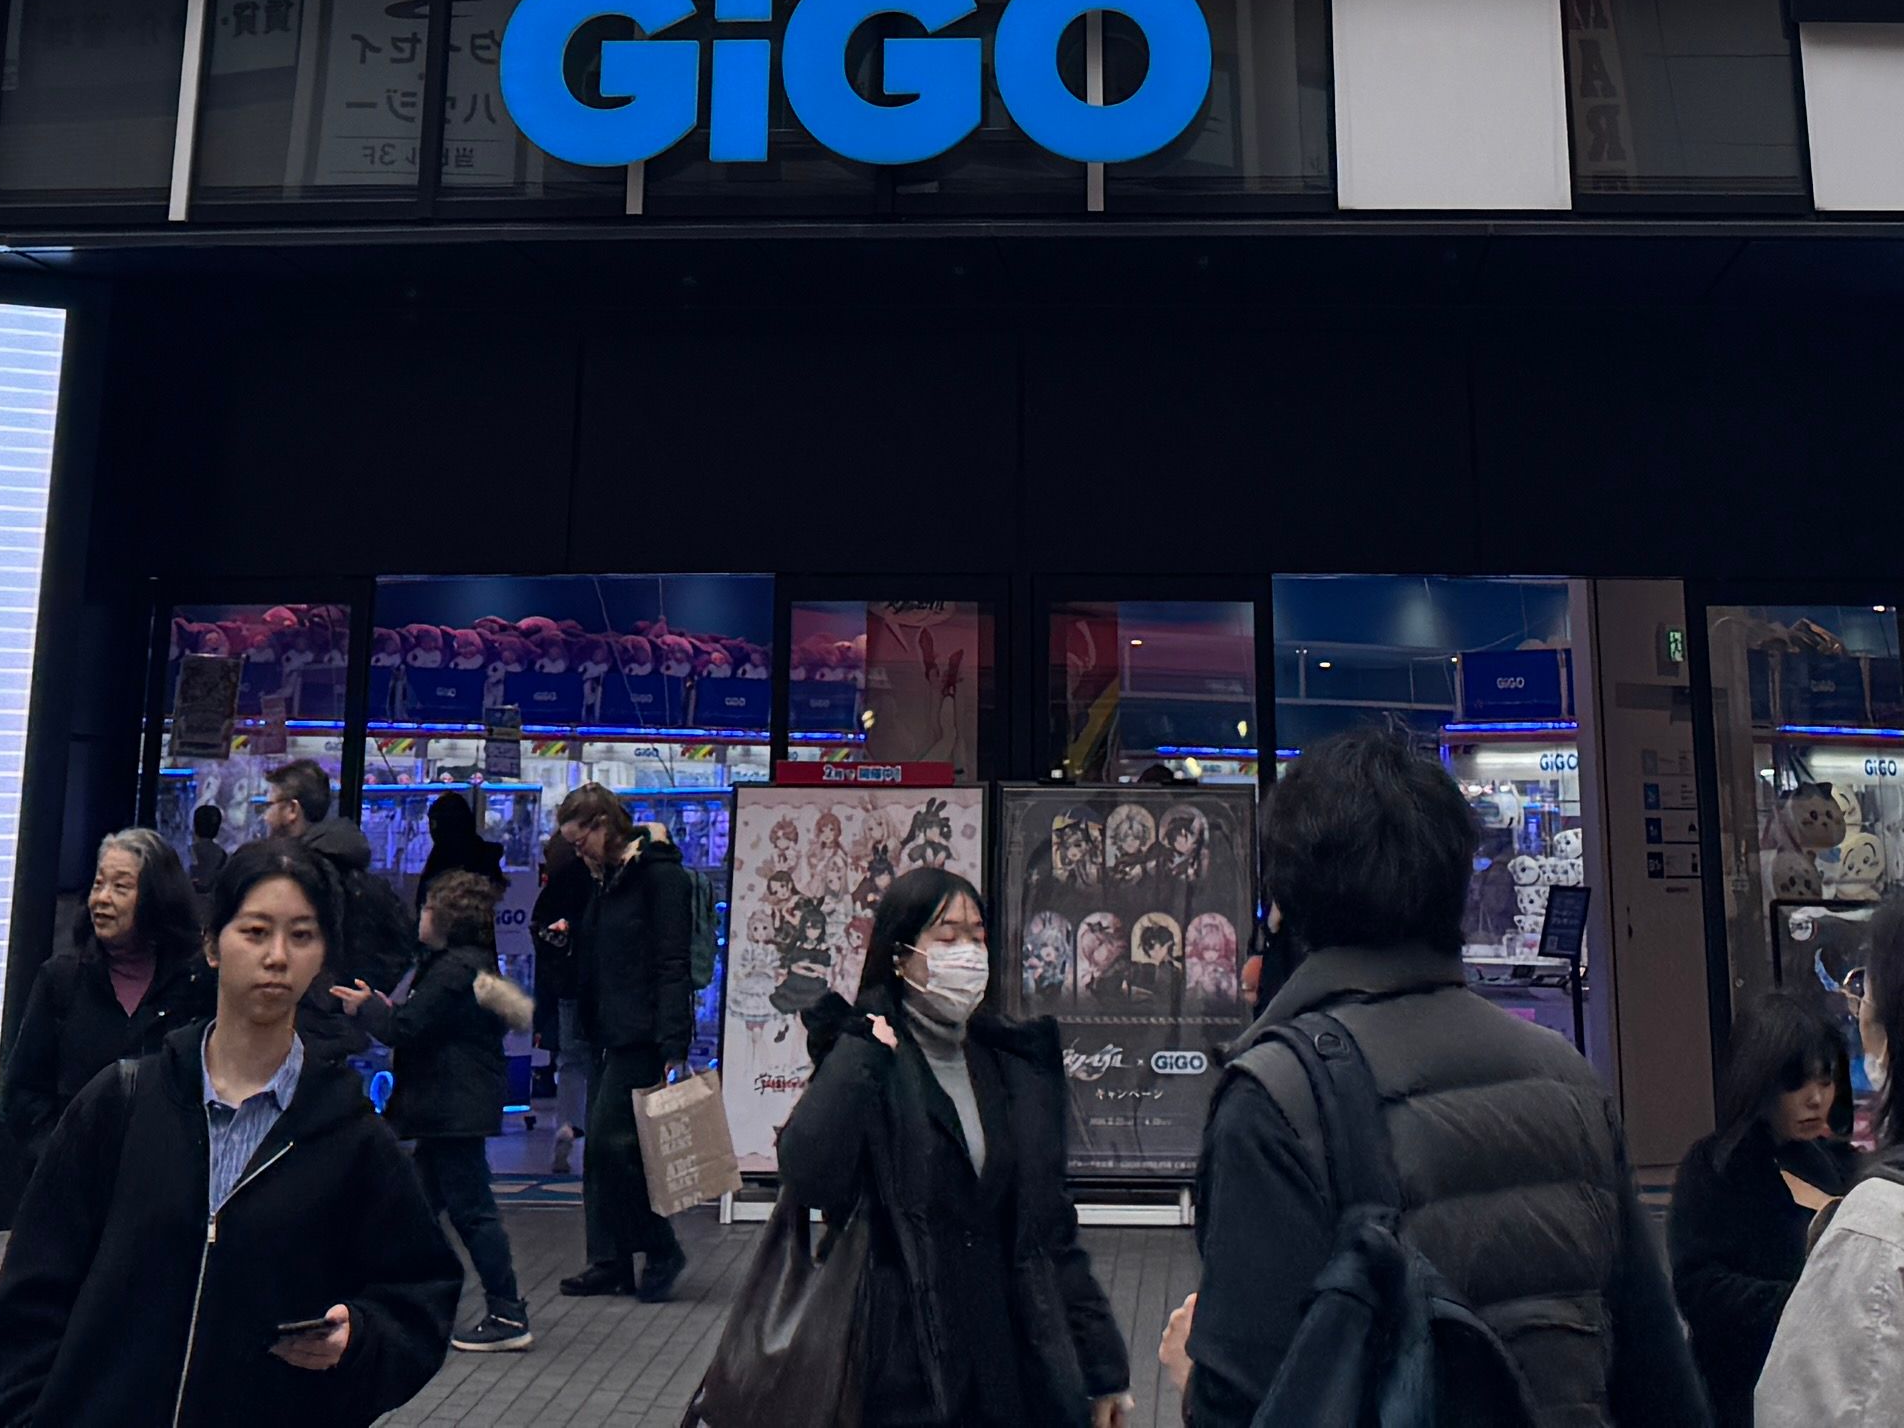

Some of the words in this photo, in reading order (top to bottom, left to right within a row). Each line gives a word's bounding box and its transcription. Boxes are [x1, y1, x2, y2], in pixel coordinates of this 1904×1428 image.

[1539, 753, 1578, 772] GiGO
[1864, 759, 1897, 777] GiGO
[1154, 1055, 1204, 1071] GiGO
